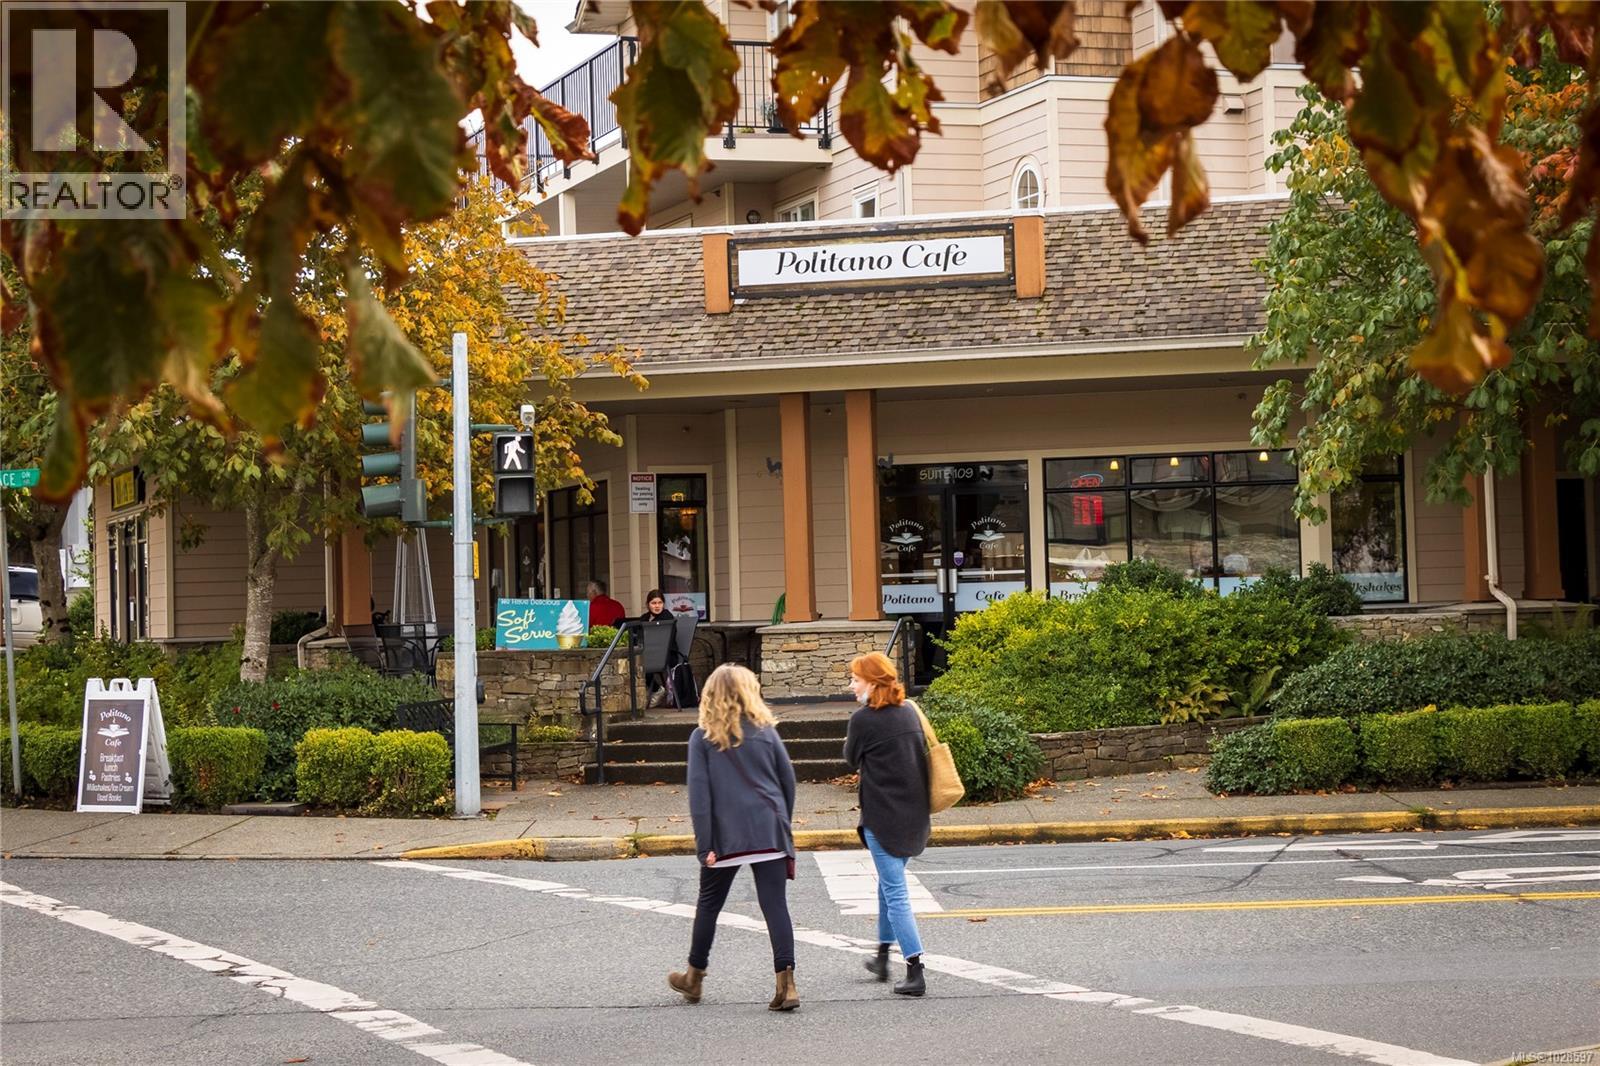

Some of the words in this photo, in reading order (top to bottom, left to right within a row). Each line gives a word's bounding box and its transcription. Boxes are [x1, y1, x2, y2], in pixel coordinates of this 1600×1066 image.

[775, 249, 892, 275] Politano
[902, 243, 967, 272] Cafe
[919, 468, 951, 480] SUITE
[953, 467, 974, 479] 109
[1072, 477, 1101, 488] OPEN
[889, 518, 925, 532] Politano
[971, 515, 1006, 530] Politano
[897, 544, 916, 553] Cafe
[979, 541, 999, 550] Cafe
[883, 594, 935, 605] Politano
[975, 590, 1005, 601] Cafe
[497, 609, 536, 629] Soft
[504, 626, 555, 643] Serve
[100, 708, 132, 722] Politano
[105, 738, 122, 748] Cafe
[99, 752, 124, 762] Breakfast
